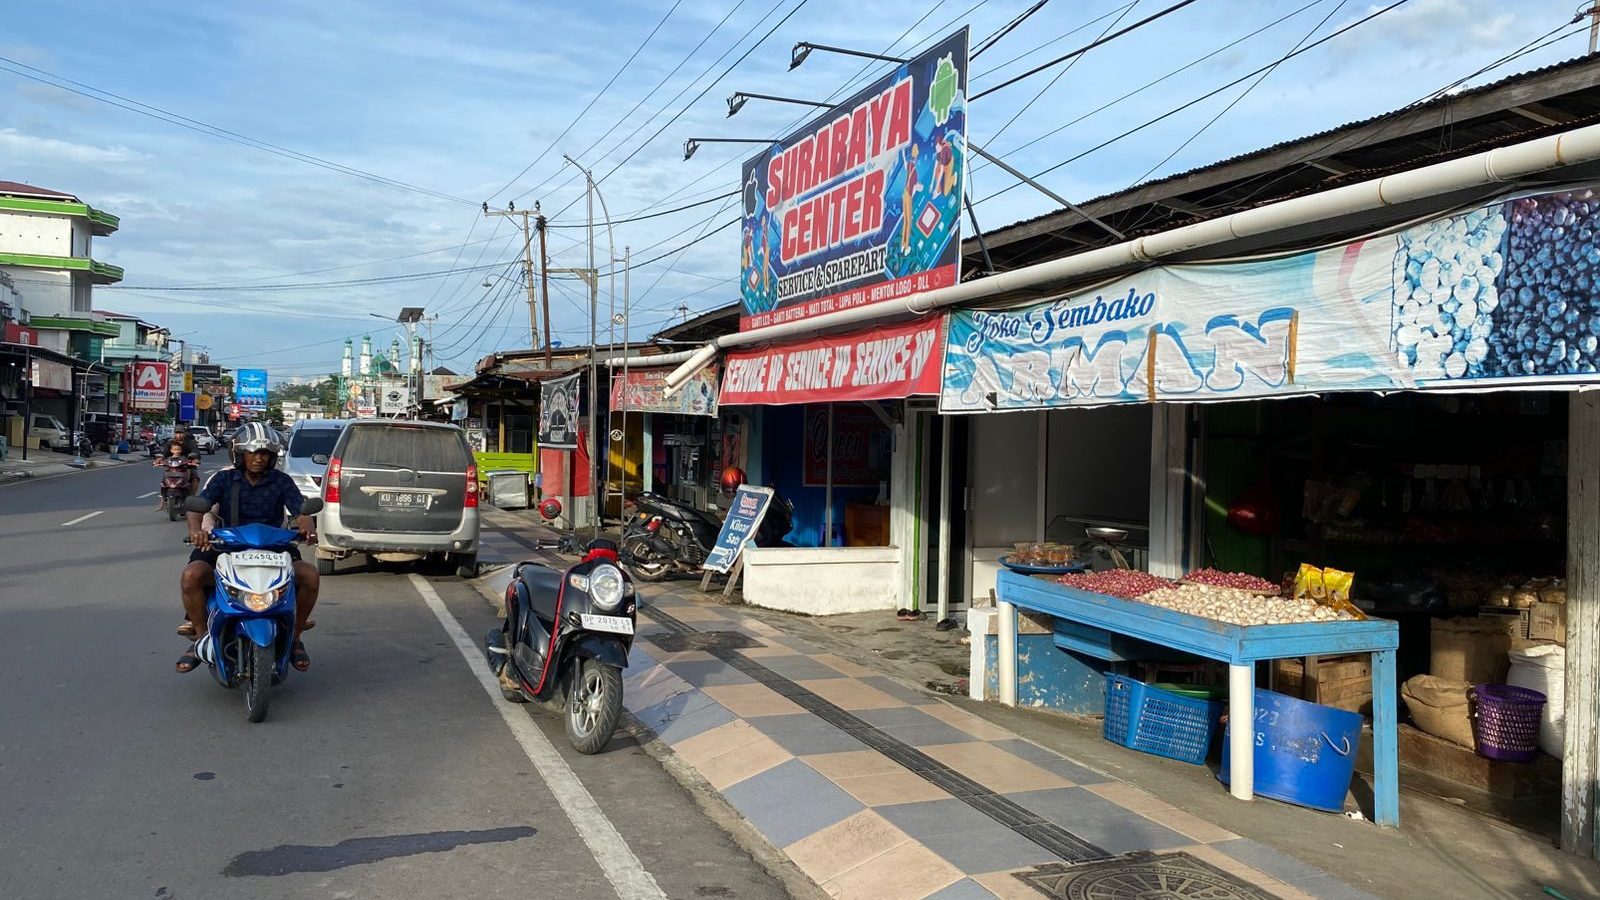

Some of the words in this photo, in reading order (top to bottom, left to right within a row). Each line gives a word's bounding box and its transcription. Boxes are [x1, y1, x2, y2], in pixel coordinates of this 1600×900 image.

[767, 77, 911, 210] SURABAYA
[782, 170, 884, 262] CENTER
[778, 270, 814, 298] SERVICE
[815, 266, 824, 290] &
[825, 247, 887, 285] SPAREPART
[821, 299, 834, 312] TOTAL
[839, 293, 851, 308] LUPA
[852, 290, 866, 305] POLA
[871, 284, 895, 300] MENTOK
[896, 279, 912, 294] LOGO
[918, 275, 929, 290] DLL
[966, 311, 1021, 353] Toko
[1024, 288, 1156, 344] Sembako
[725, 356, 769, 392] SERVICE
[766, 353, 784, 391] HP
[785, 347, 832, 390] SERVICE
[831, 345, 851, 387] HP
[852, 335, 913, 386] SERVICE
[960, 308, 1298, 404] ARMAN
